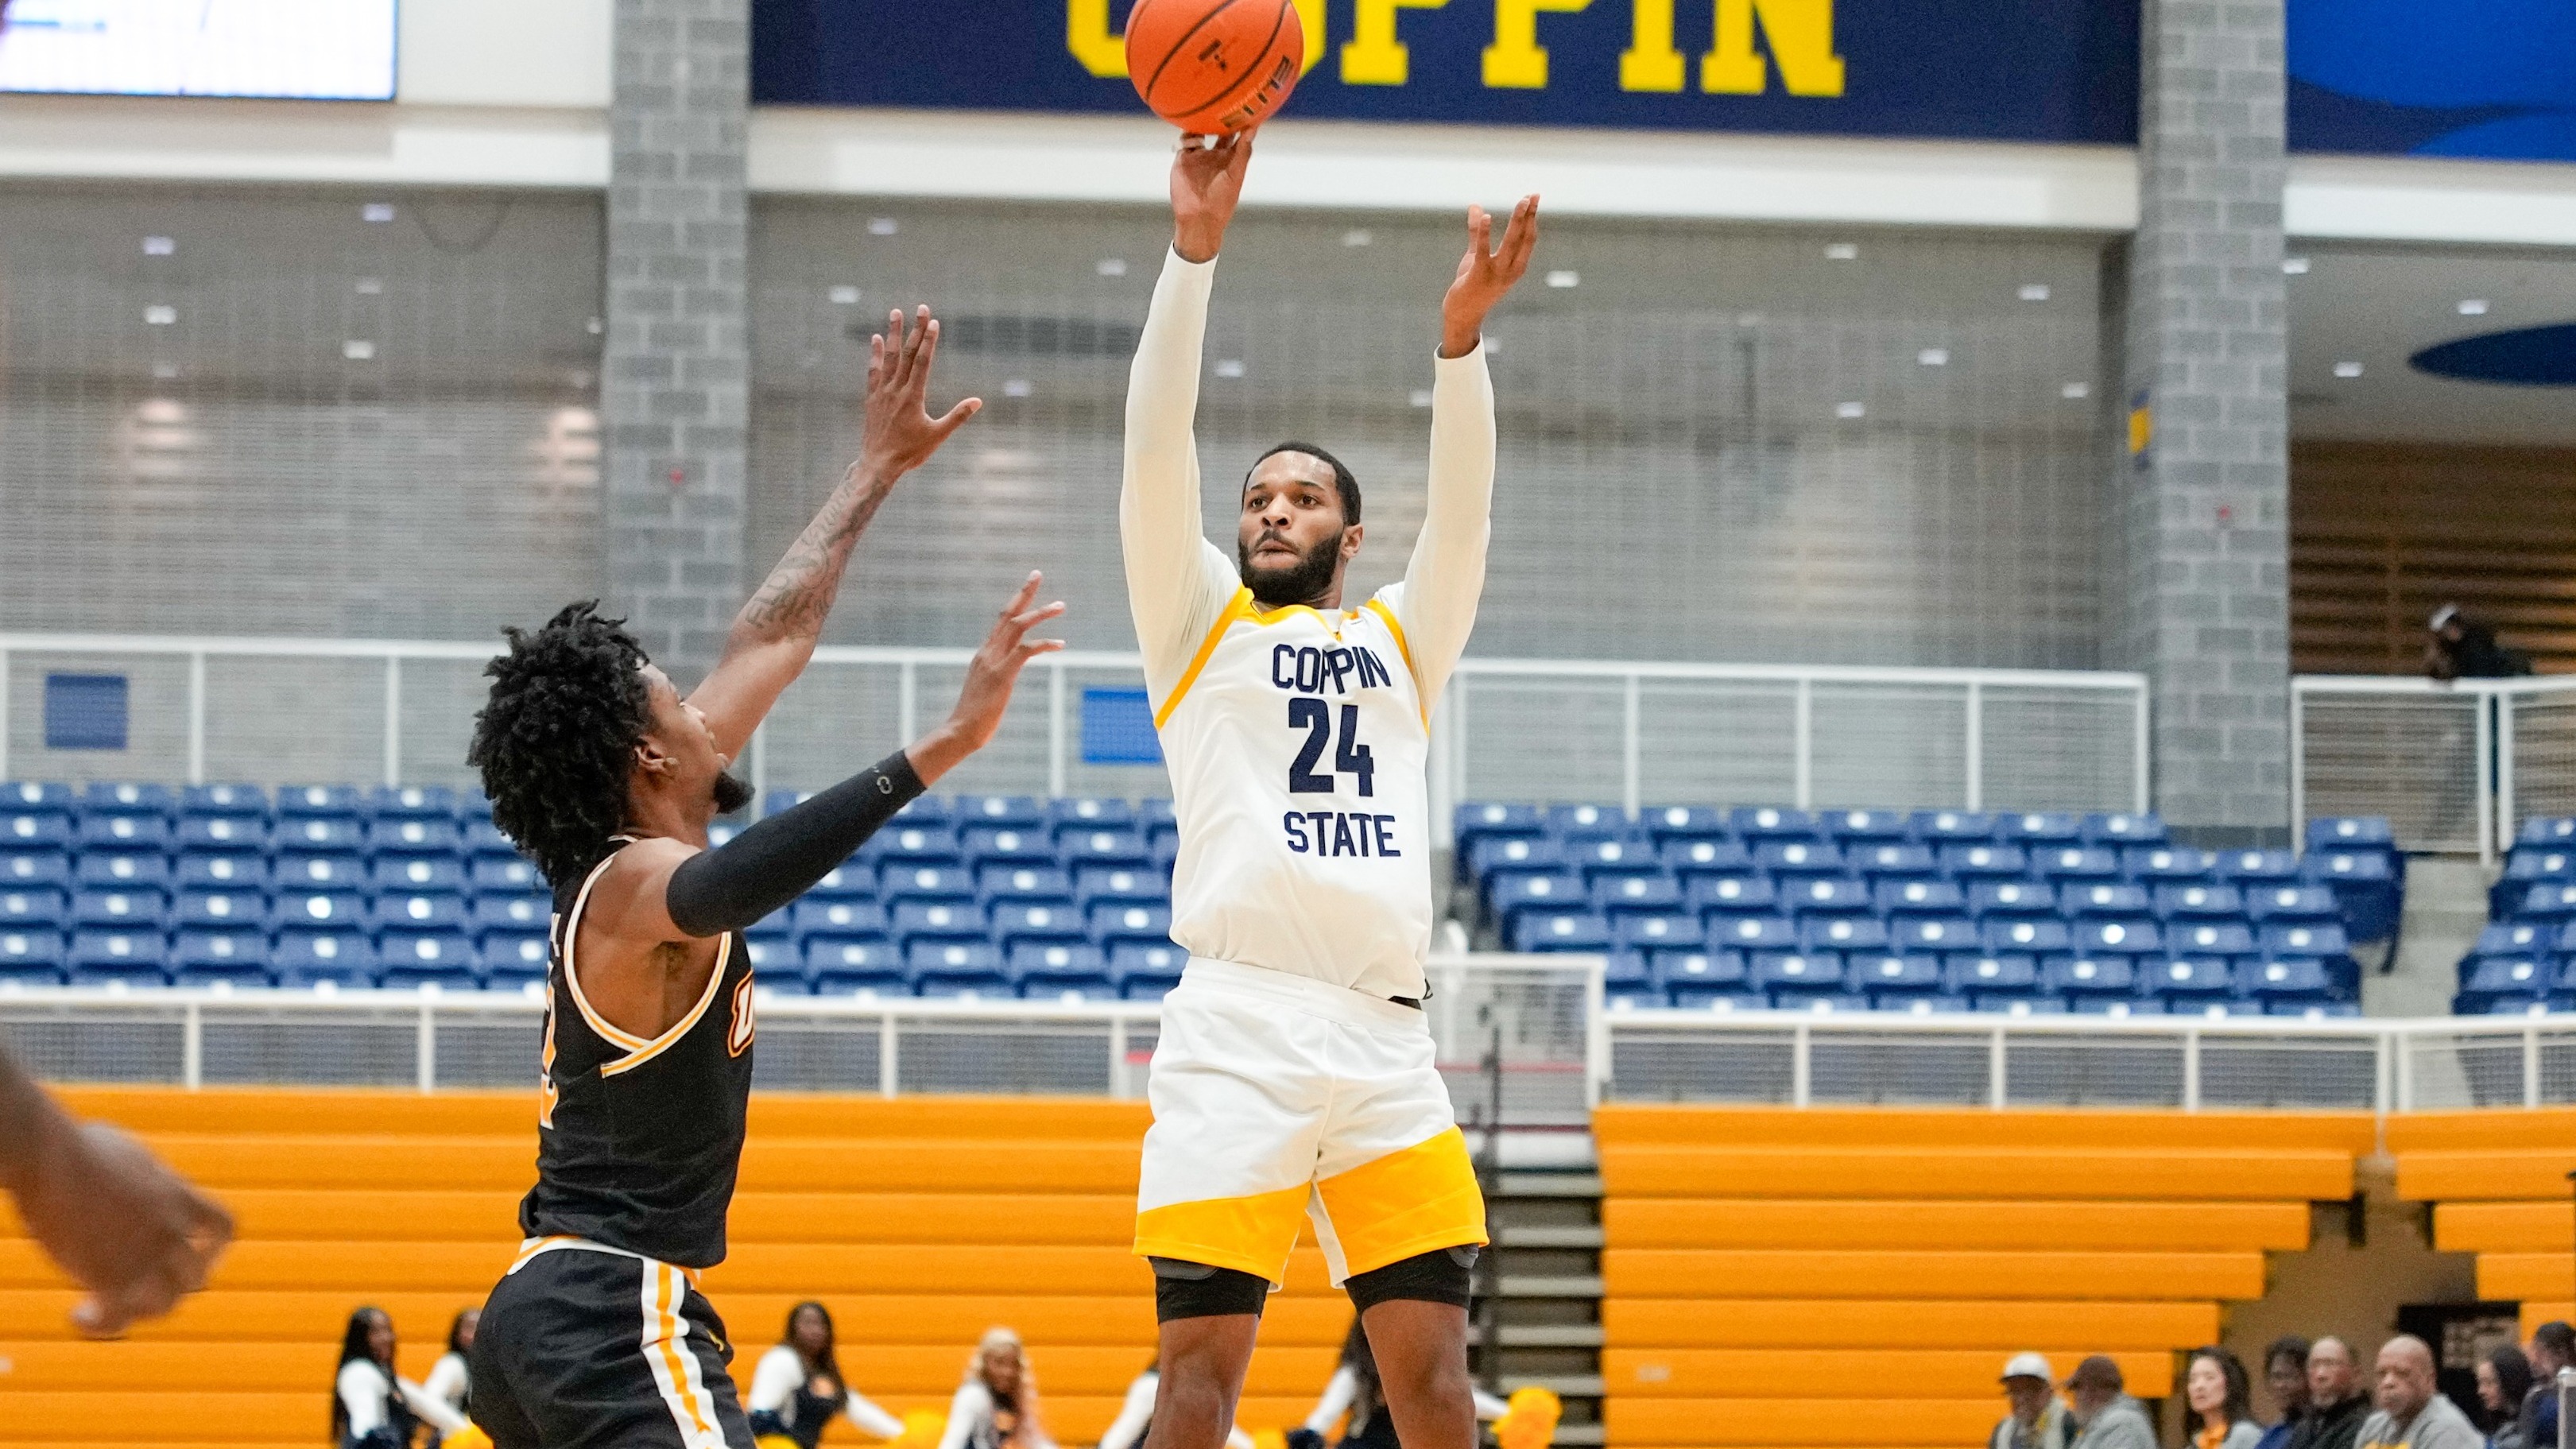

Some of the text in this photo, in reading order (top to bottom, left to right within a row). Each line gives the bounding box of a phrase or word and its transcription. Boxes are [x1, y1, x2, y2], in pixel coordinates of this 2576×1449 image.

[1067, 0, 1846, 97] PPIN
[1220, 54, 1295, 130] ELITE
[1272, 644, 1392, 695] COPPIN
[1288, 697, 1374, 797] 24
[1284, 811, 1401, 858] STATE
